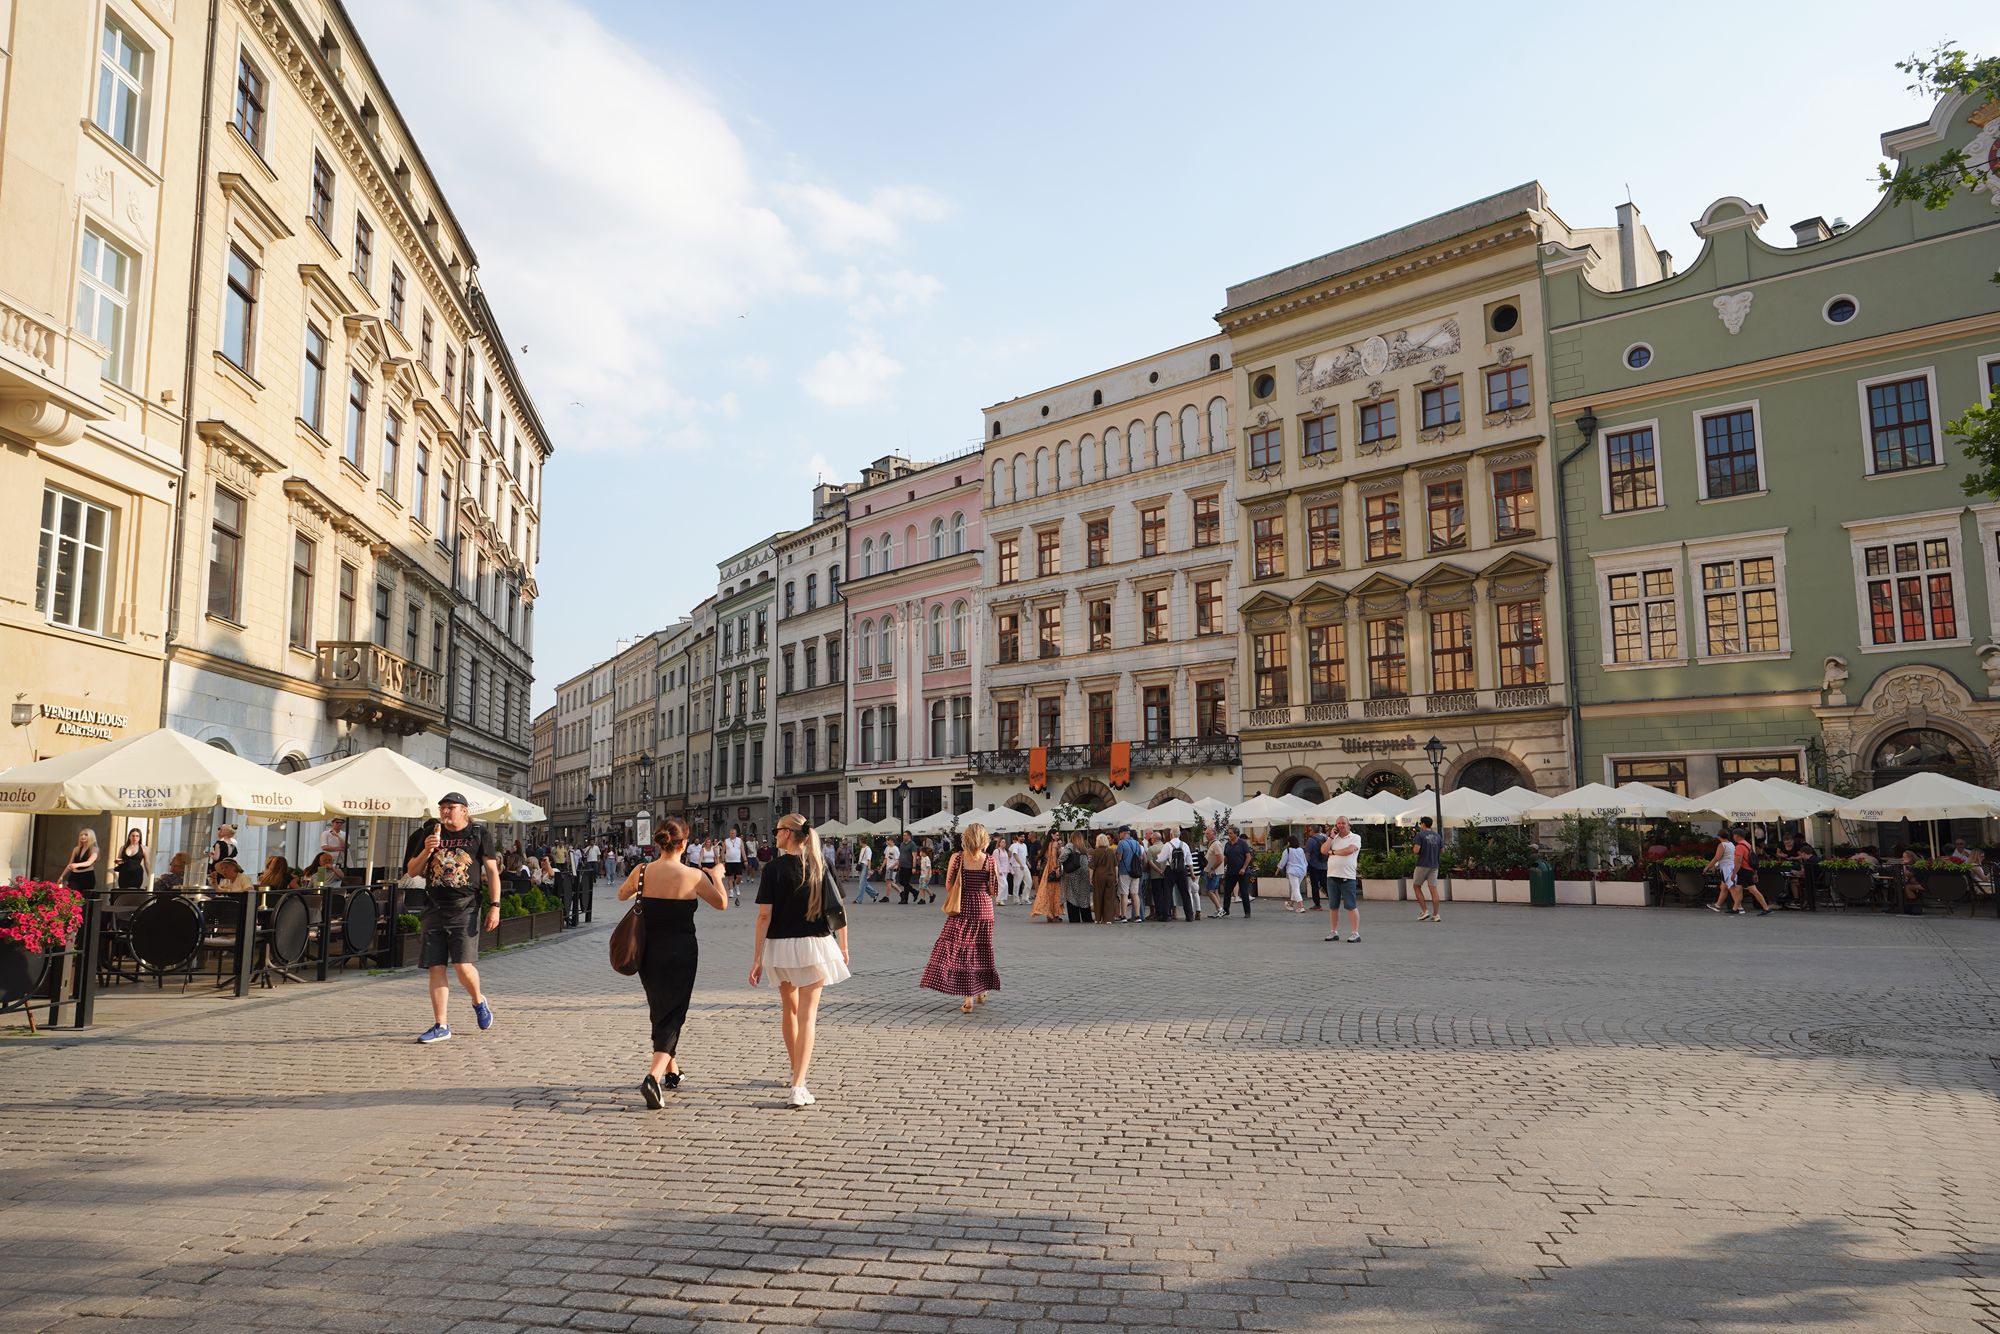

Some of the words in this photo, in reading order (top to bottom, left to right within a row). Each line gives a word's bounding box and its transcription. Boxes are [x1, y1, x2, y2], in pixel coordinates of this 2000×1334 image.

[42, 704, 96, 724] VENETIAN
[97, 712, 128, 727] HOUSE
[59, 723, 113, 739] APARTHOTEL
[1265, 740, 1323, 750] RESTAURACJA
[1338, 734, 1416, 755] Wierzynek
[118, 788, 171, 798] PERONI
[251, 792, 293, 806] molto
[342, 798, 391, 811] molto
